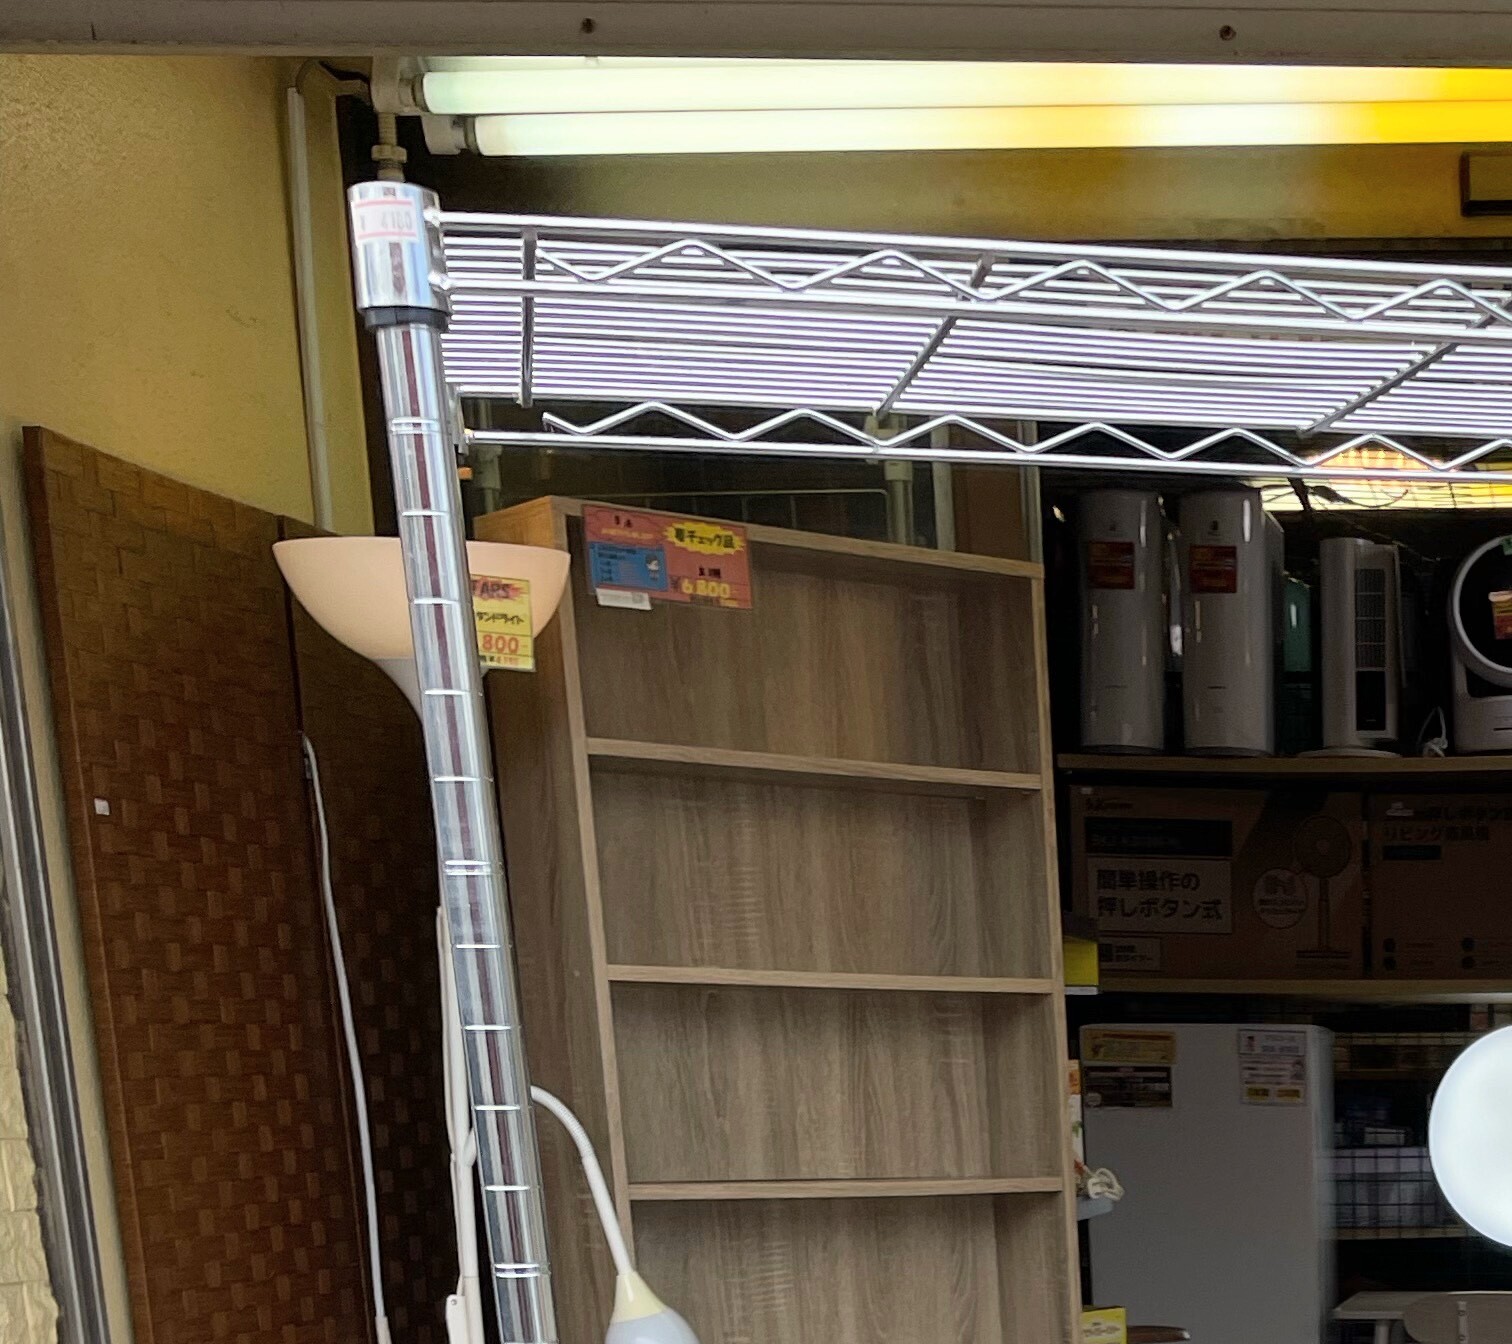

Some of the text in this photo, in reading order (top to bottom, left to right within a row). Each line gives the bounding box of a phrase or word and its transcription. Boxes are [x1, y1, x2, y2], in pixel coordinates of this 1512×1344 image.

[1097, 868, 1200, 892] 簡単操作の
[1098, 896, 1221, 921] 押しボタン式
